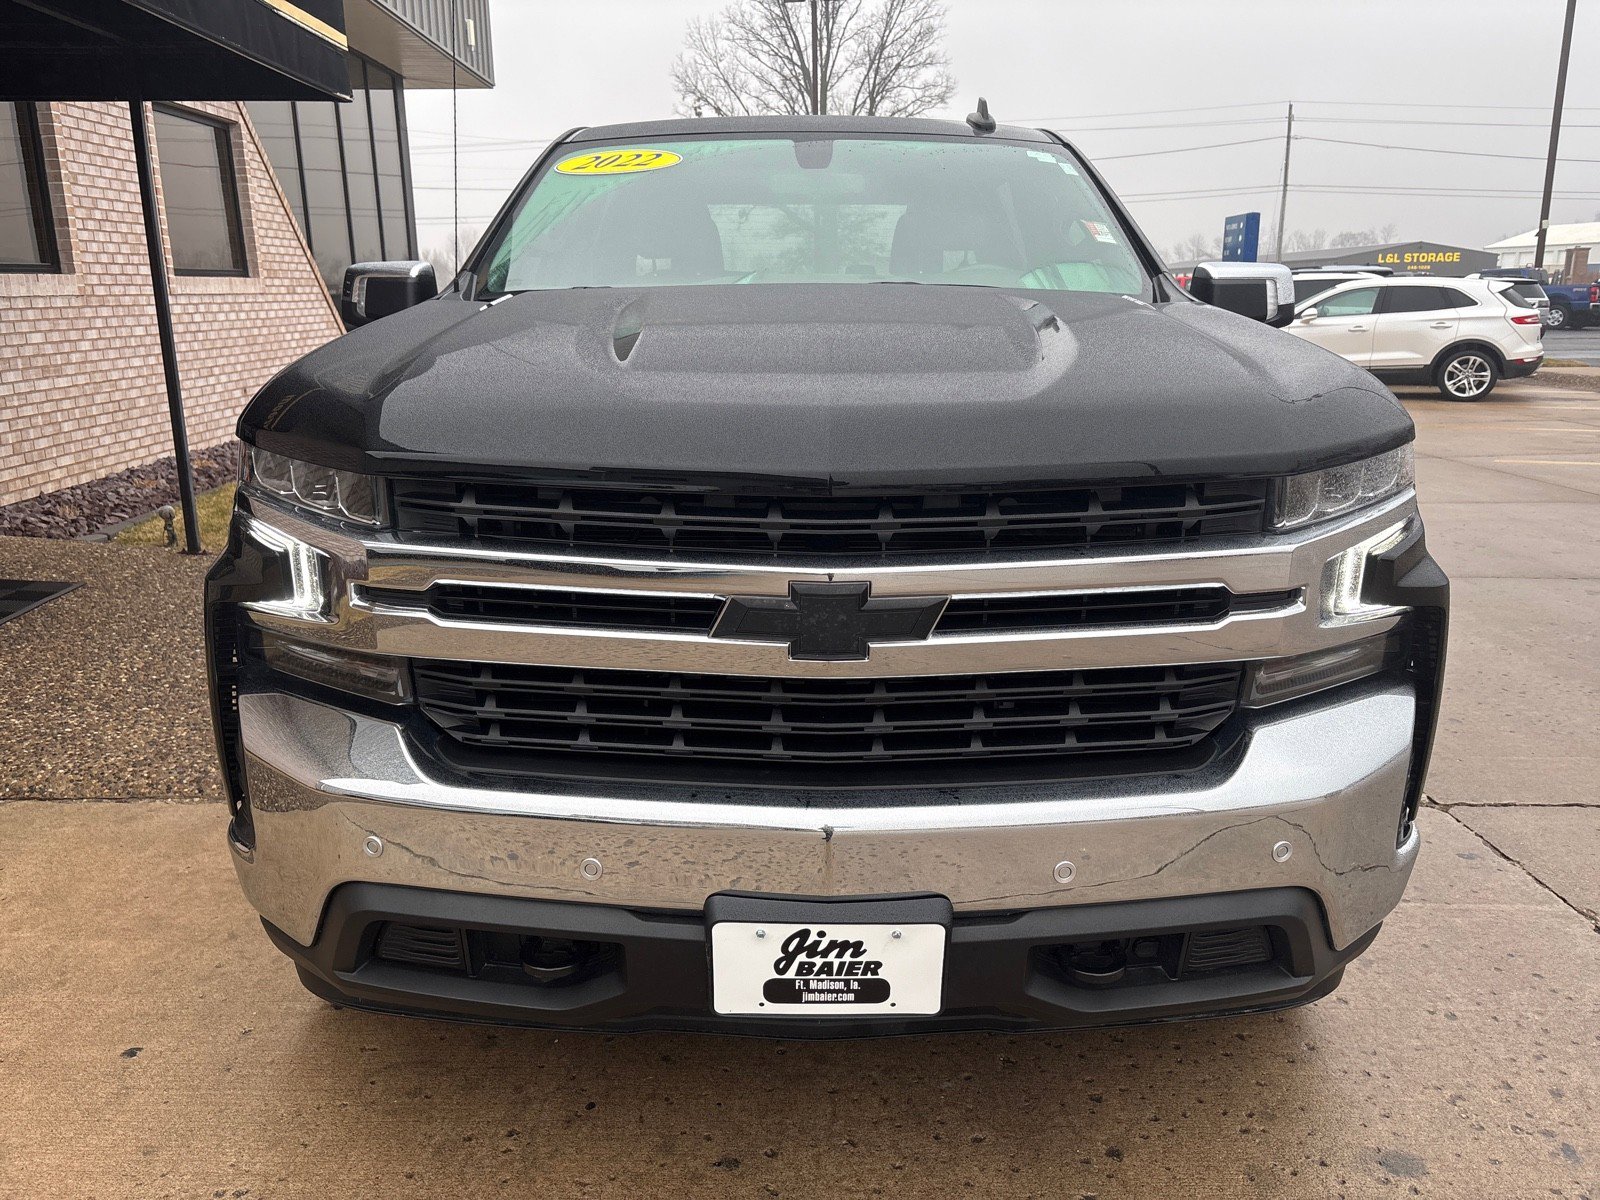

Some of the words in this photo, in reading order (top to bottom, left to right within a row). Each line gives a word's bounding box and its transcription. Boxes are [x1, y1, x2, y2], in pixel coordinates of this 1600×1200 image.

[570, 153, 663, 171] 2022
[1377, 253, 1400, 264] L&L
[1403, 252, 1461, 263] STORAGE
[773, 928, 868, 977] Jim
[794, 960, 883, 977] BAIER
[795, 979, 806, 990] Ft.
[809, 979, 847, 991] Madison,
[801, 991, 855, 1003] jimbaier.com
